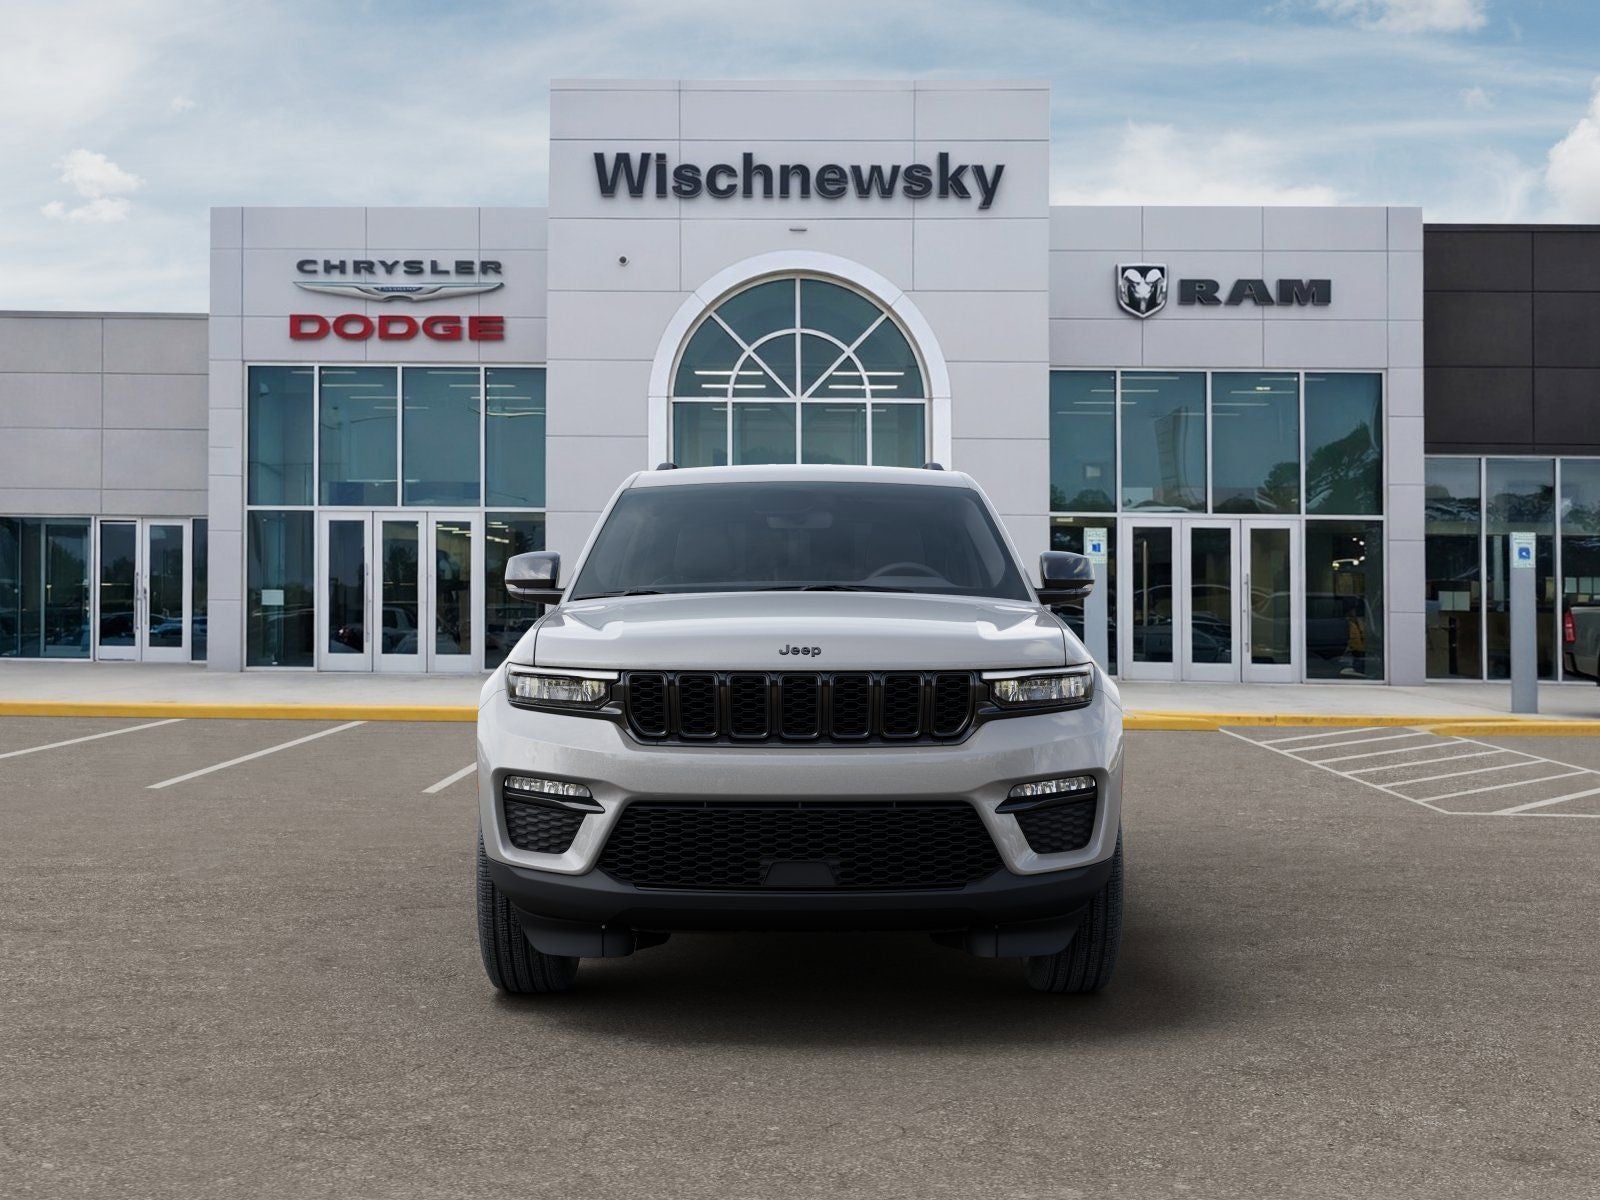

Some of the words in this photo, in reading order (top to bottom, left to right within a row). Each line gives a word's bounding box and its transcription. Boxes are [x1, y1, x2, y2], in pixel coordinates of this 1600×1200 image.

[593, 152, 1006, 210] Wischnewsky
[296, 259, 503, 275] CHRYSLER
[1177, 278, 1332, 306] RAM
[289, 313, 505, 341] DODGE
[778, 644, 822, 658] Jeep
